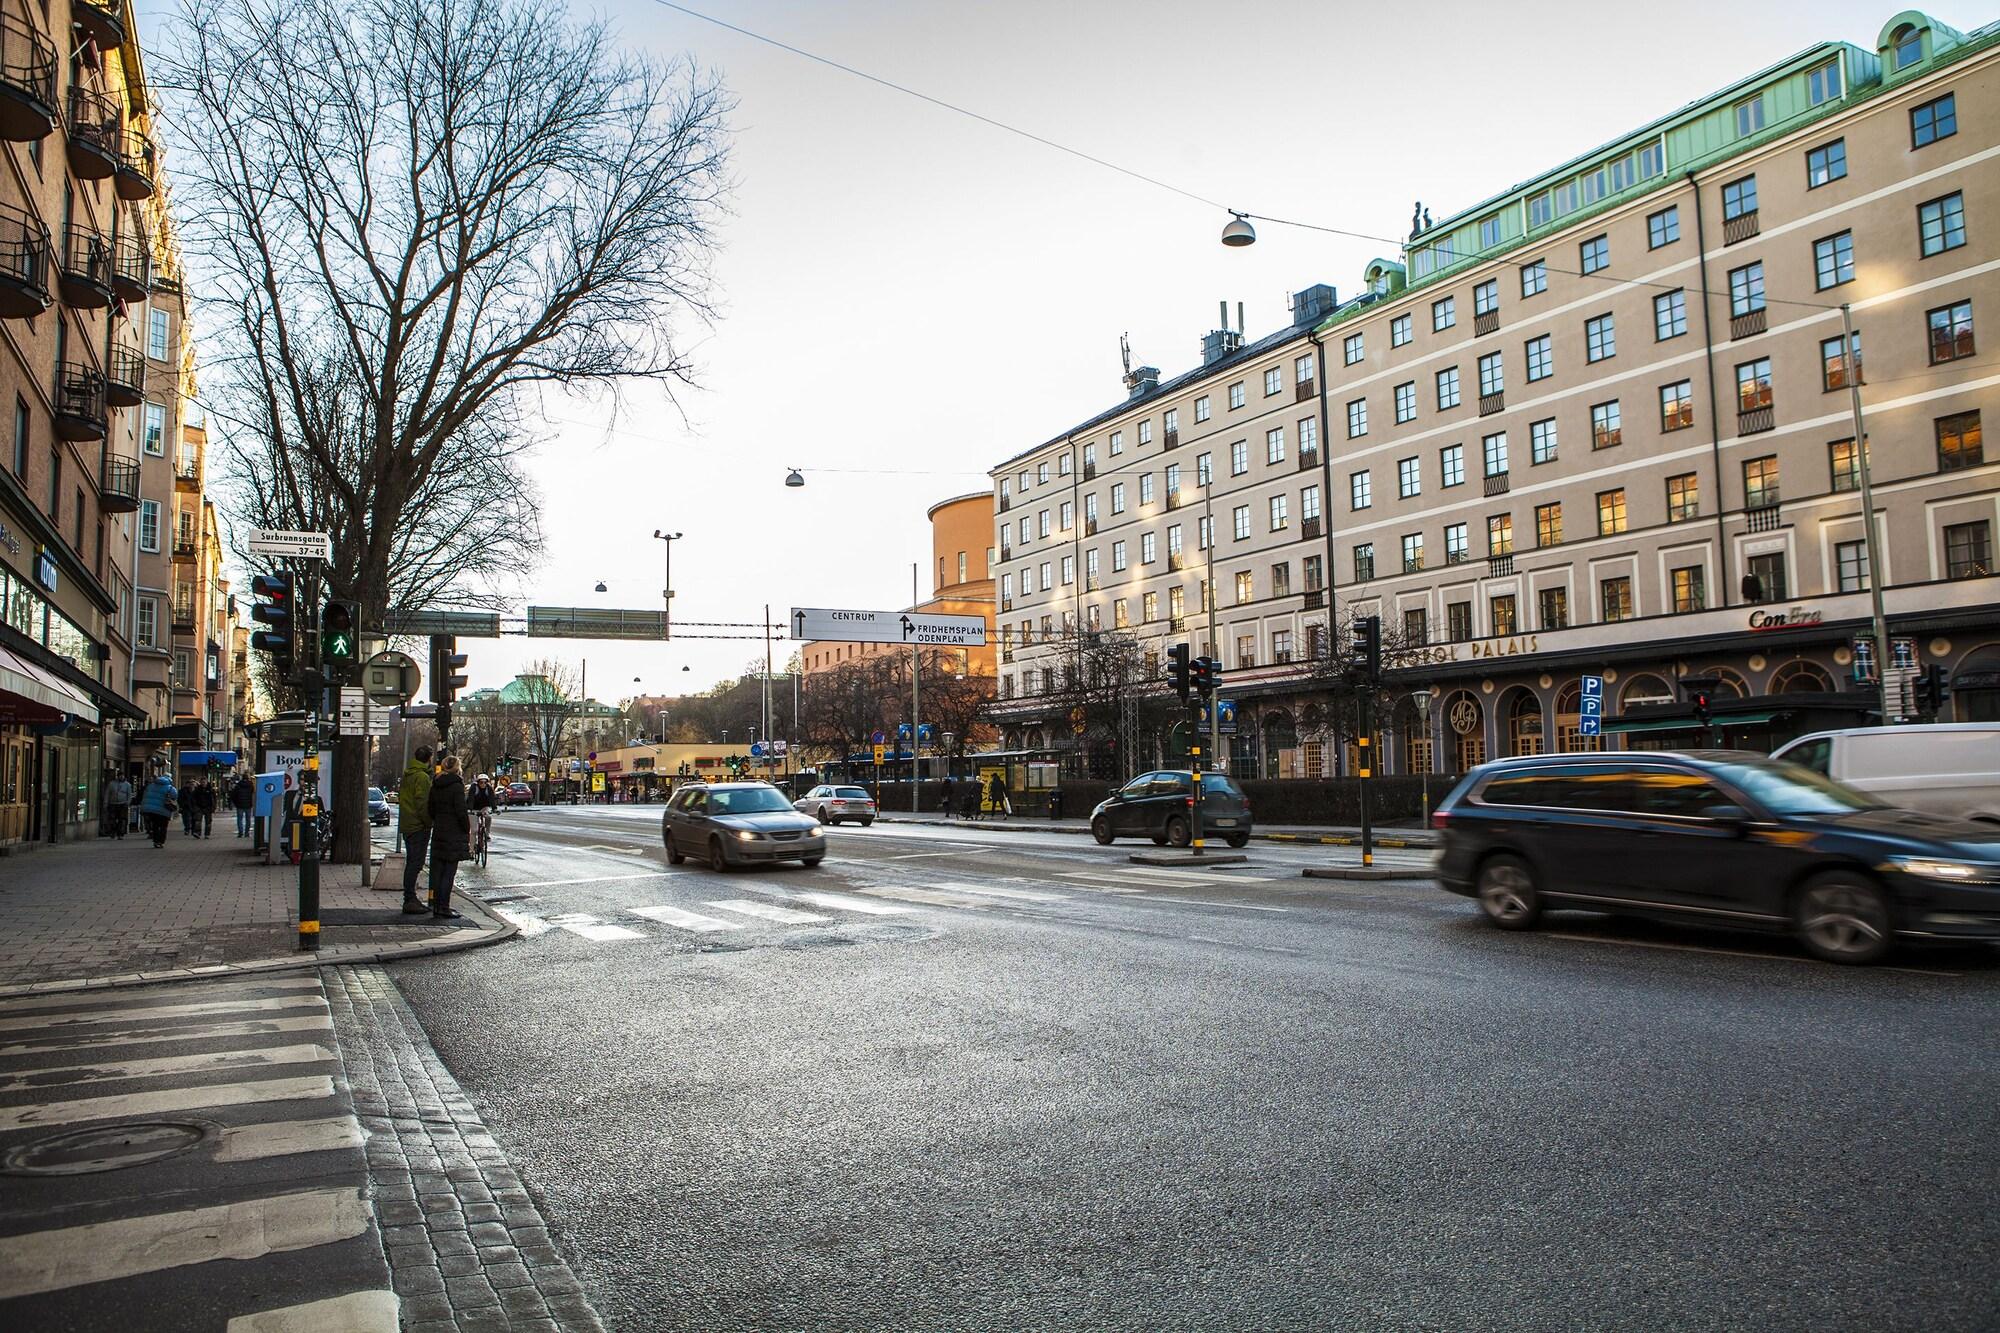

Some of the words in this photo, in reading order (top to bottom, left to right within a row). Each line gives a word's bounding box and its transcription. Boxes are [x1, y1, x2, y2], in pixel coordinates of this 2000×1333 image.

[261, 532, 325, 544] Surbrunnsgatan
[831, 612, 875, 621] CENTRUM
[917, 624, 983, 635] FRIDHEMSPLAN
[917, 634, 965, 644] ODENPLAN
[1472, 635, 1537, 658] PALAIS
[1586, 678, 1598, 693] P
[1587, 701, 1596, 714] P
